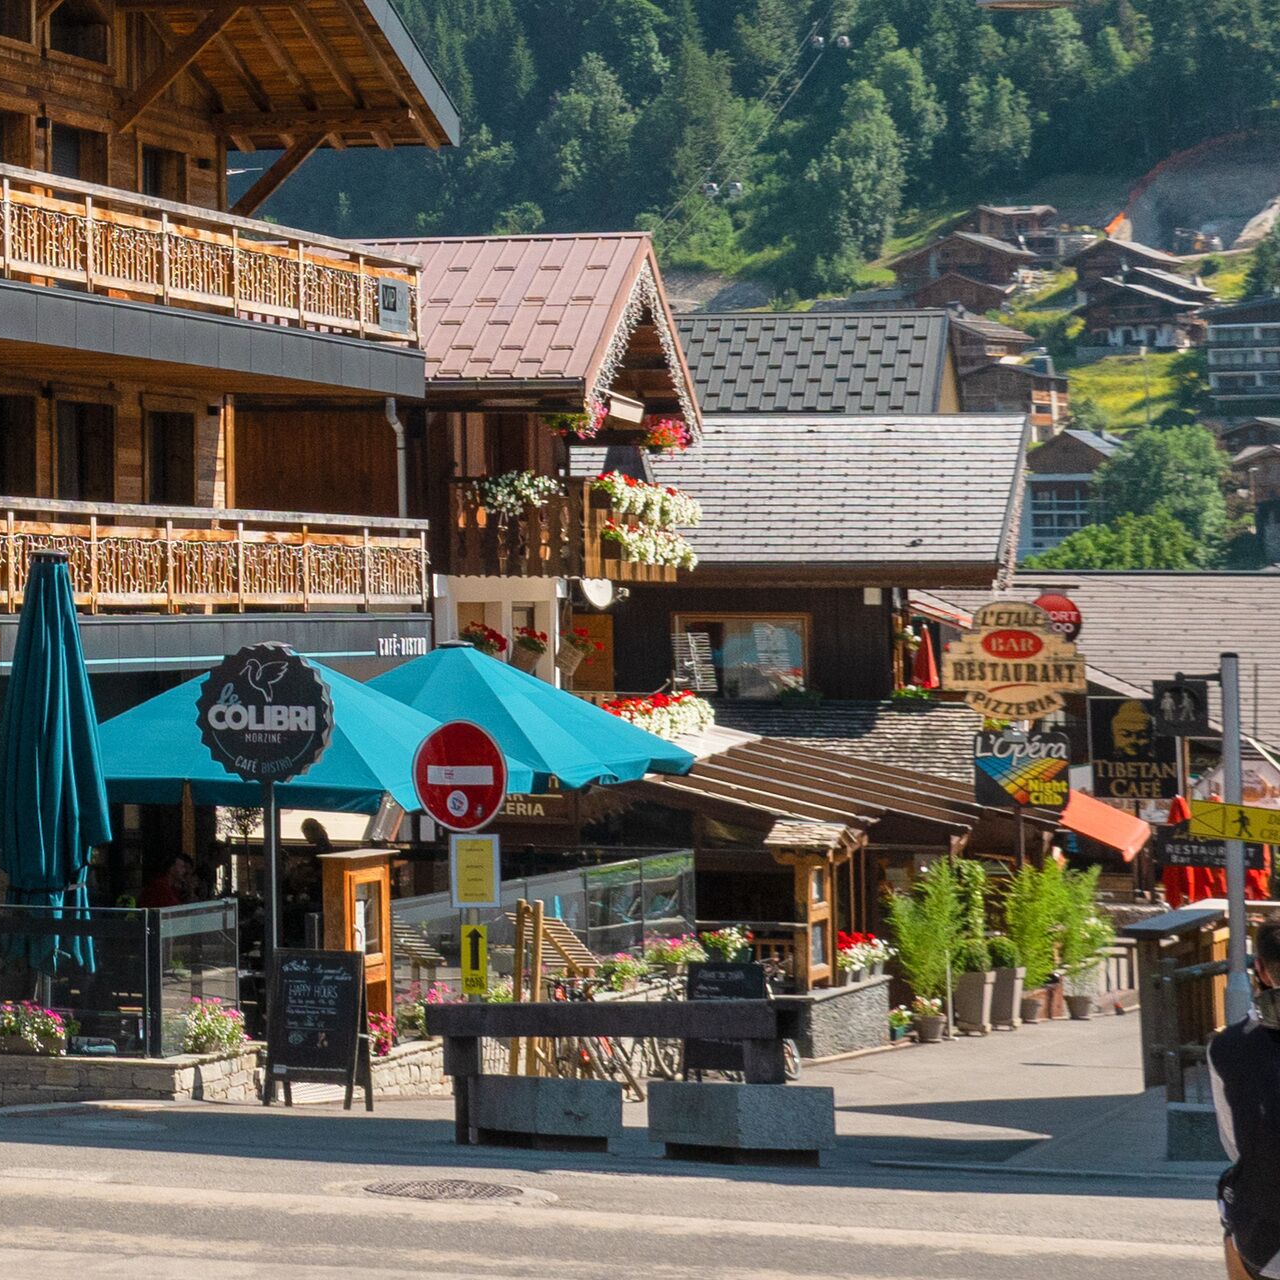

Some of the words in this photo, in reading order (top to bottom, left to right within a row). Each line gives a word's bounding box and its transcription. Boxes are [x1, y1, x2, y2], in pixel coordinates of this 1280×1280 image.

[981, 611, 1042, 627] L'ETALE
[1048, 610, 1077, 621] ORT
[990, 639, 1035, 651] BAR
[952, 662, 1077, 683] RESTAURANT
[972, 692, 1057, 715] PIZZERIA
[207, 703, 316, 731] COLIBRI
[245, 733, 282, 743] MORZINE
[975, 734, 1068, 766] L'Opéra
[234, 755, 257, 773] CAFÉ
[261, 757, 293, 774] BISTRO
[1093, 760, 1176, 778] TIBETAN
[1027, 779, 1068, 796] Night
[1110, 778, 1162, 797] CAFÉ
[1029, 791, 1064, 805] Club
[499, 802, 545, 816] ERIA
